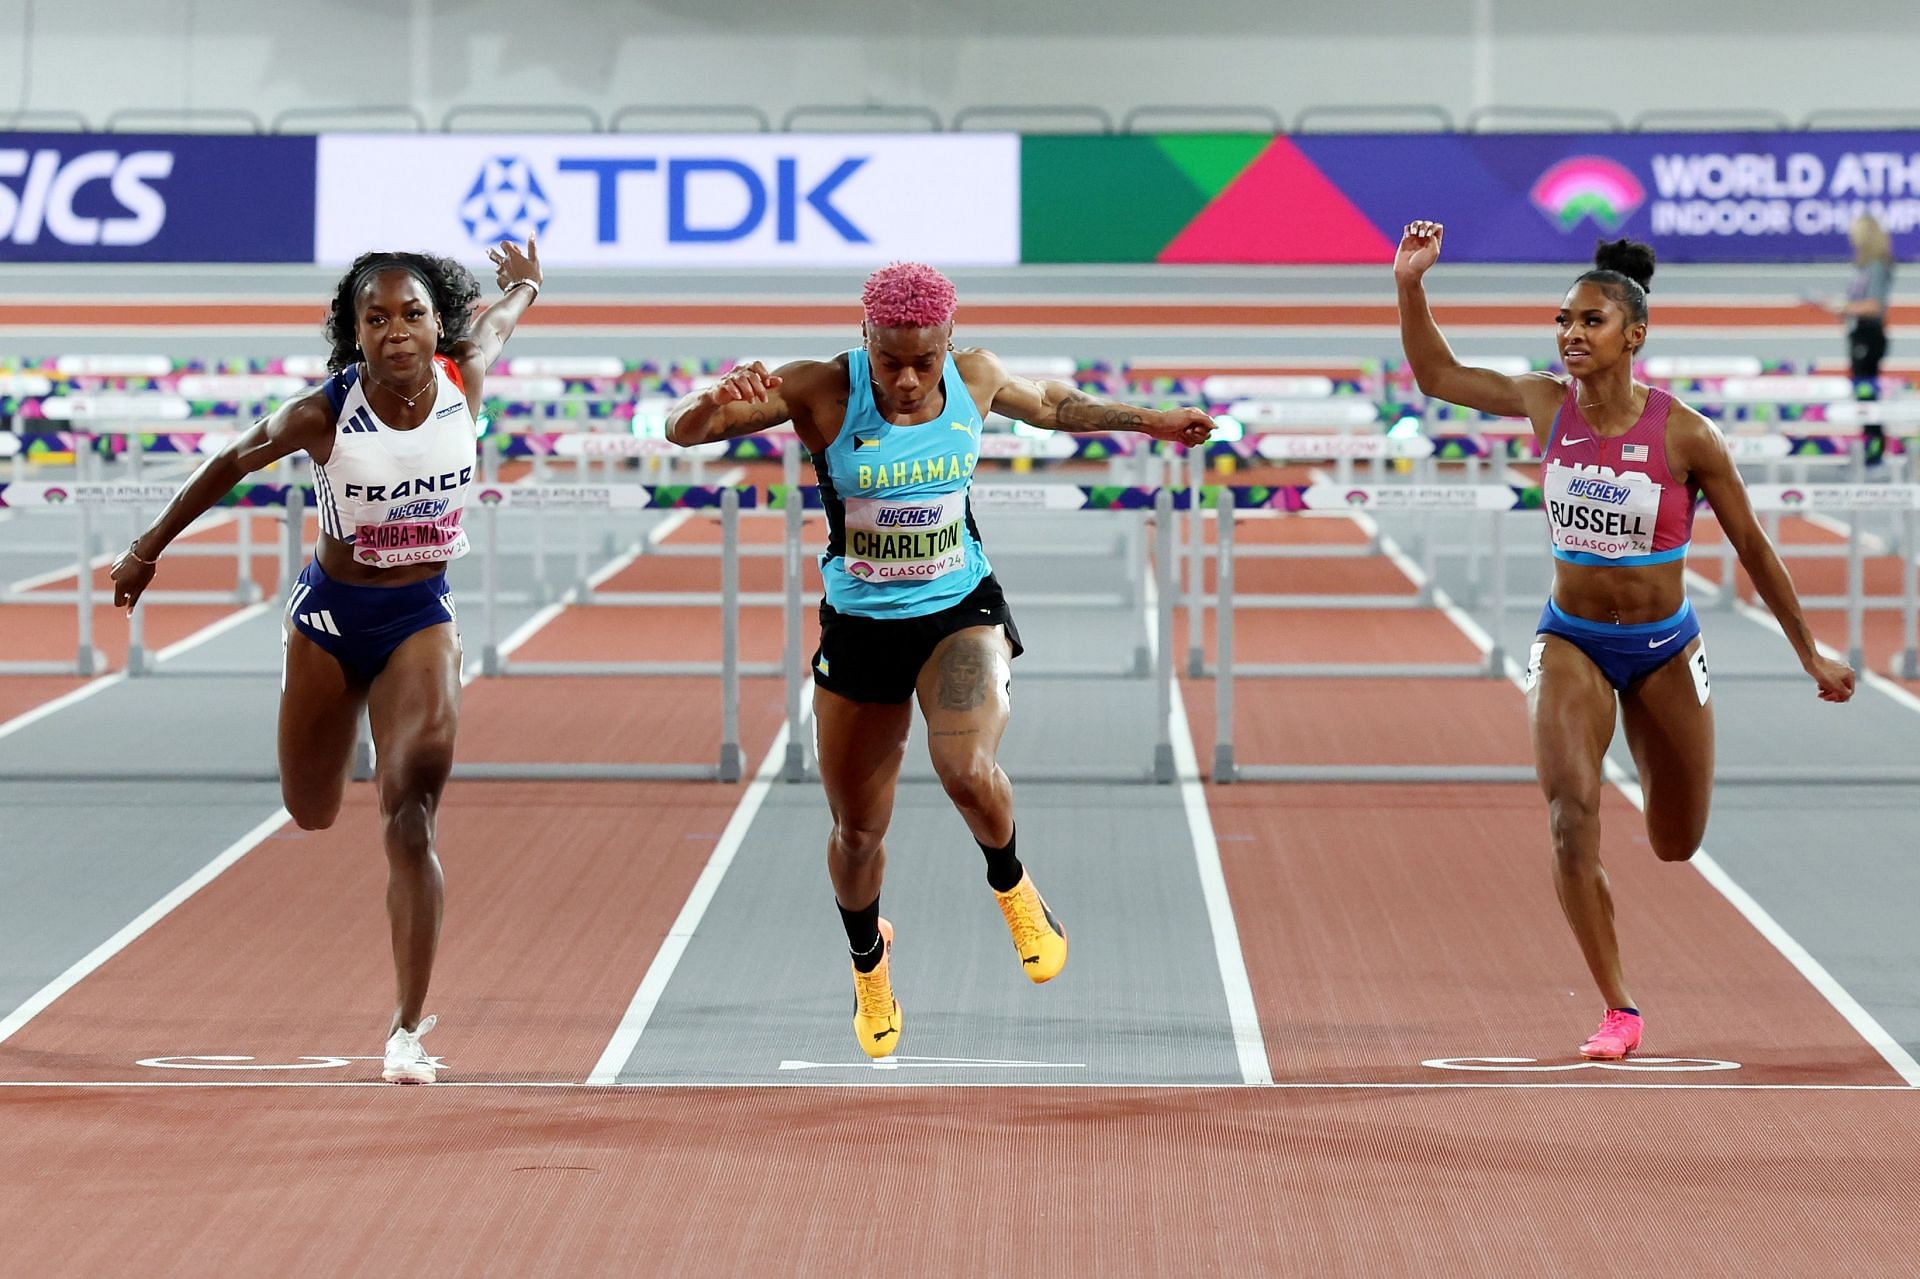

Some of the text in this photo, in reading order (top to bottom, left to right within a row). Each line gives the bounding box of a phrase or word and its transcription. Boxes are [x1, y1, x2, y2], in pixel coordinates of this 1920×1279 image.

[1651, 152, 1920, 198] WORLD ATH
[558, 159, 870, 242] TDK
[1651, 199, 1792, 236] INDOOR
[345, 466, 472, 502] FRANCE
[859, 453, 976, 489] BAHAMAS
[1567, 477, 1632, 505] HI-CHEW
[386, 497, 449, 522] HI-CHEW
[876, 504, 943, 527] HI-CHEW
[1550, 500, 1646, 536] RUSSELL
[386, 546, 455, 563] GLASGOW
[853, 522, 958, 559] CHARLTON
[1565, 535, 1646, 553] GLASGOW 24
[879, 554, 962, 577] GLASGOW 24
